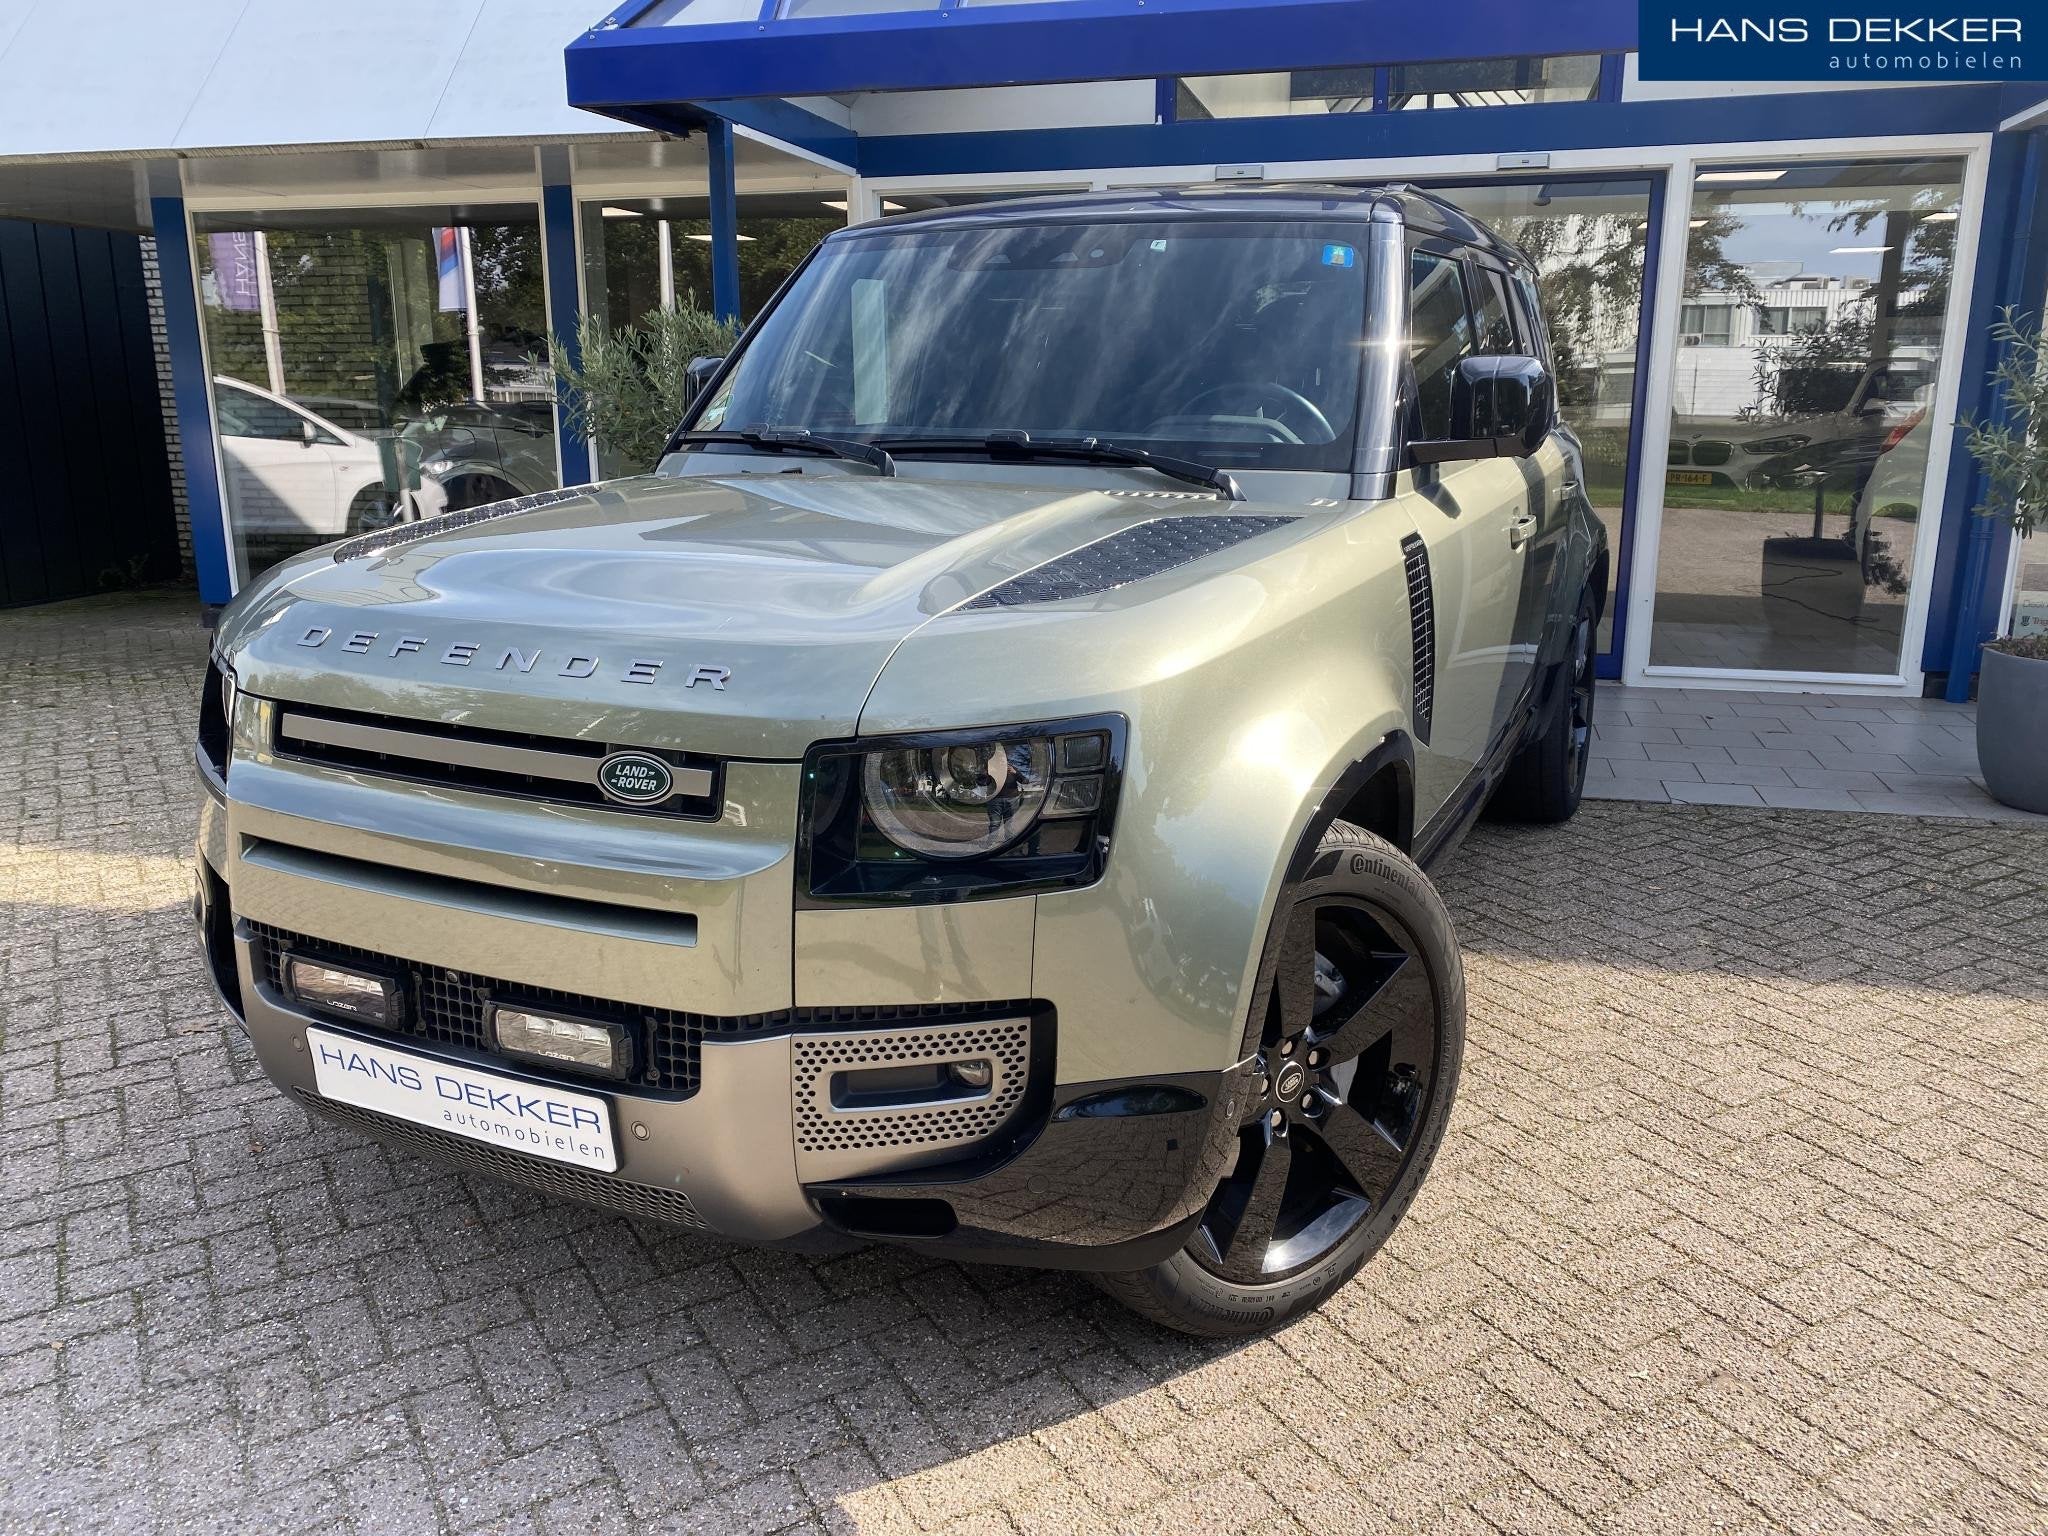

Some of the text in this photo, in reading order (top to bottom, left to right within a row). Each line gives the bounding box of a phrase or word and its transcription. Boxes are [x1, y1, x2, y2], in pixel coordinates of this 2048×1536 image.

[297, 626, 731, 691] DEFENDER
[319, 1044, 601, 1133] HANS DEKKER
[443, 1109, 605, 1160] automobielen
